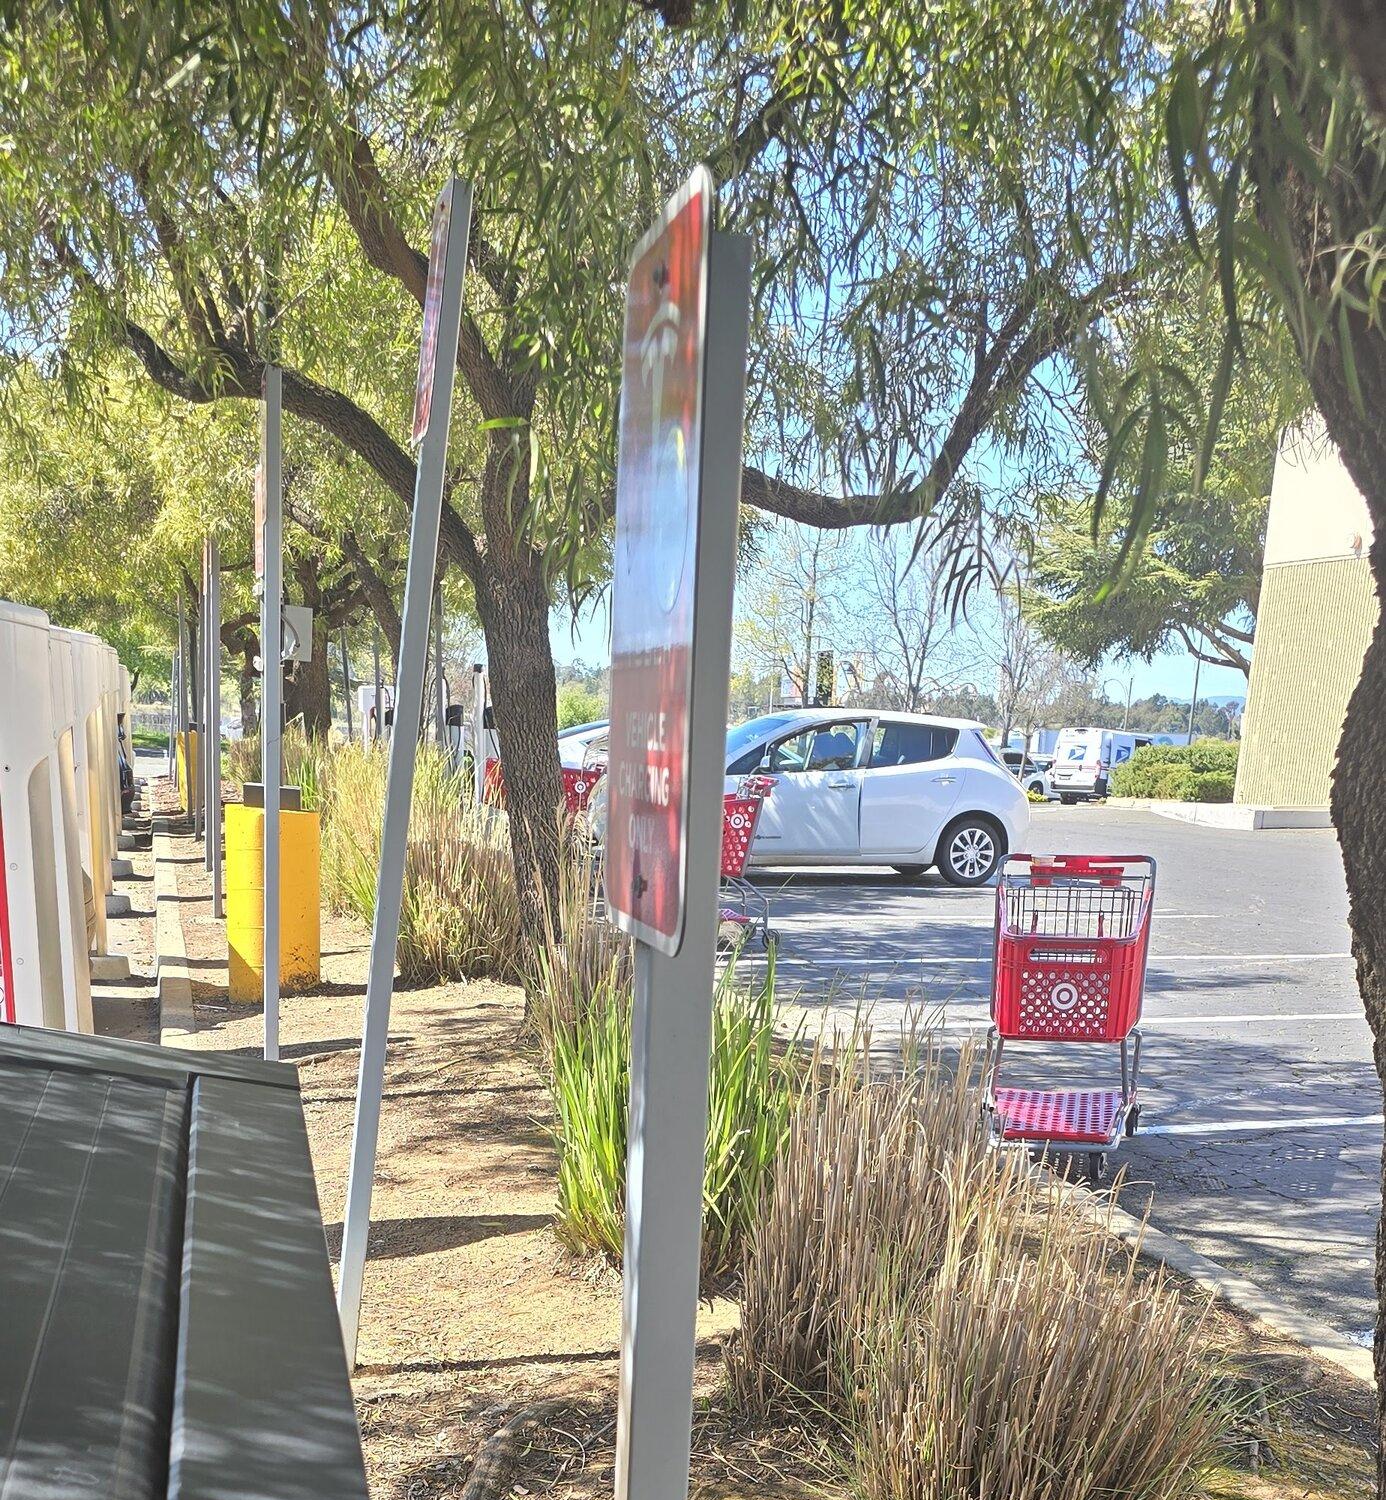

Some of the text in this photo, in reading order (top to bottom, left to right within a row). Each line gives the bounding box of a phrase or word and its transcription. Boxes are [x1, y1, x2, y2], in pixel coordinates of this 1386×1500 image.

[625, 711, 667, 752] VEHICLE
[618, 761, 670, 807] CHARGING
[628, 812, 655, 855] ONLY
